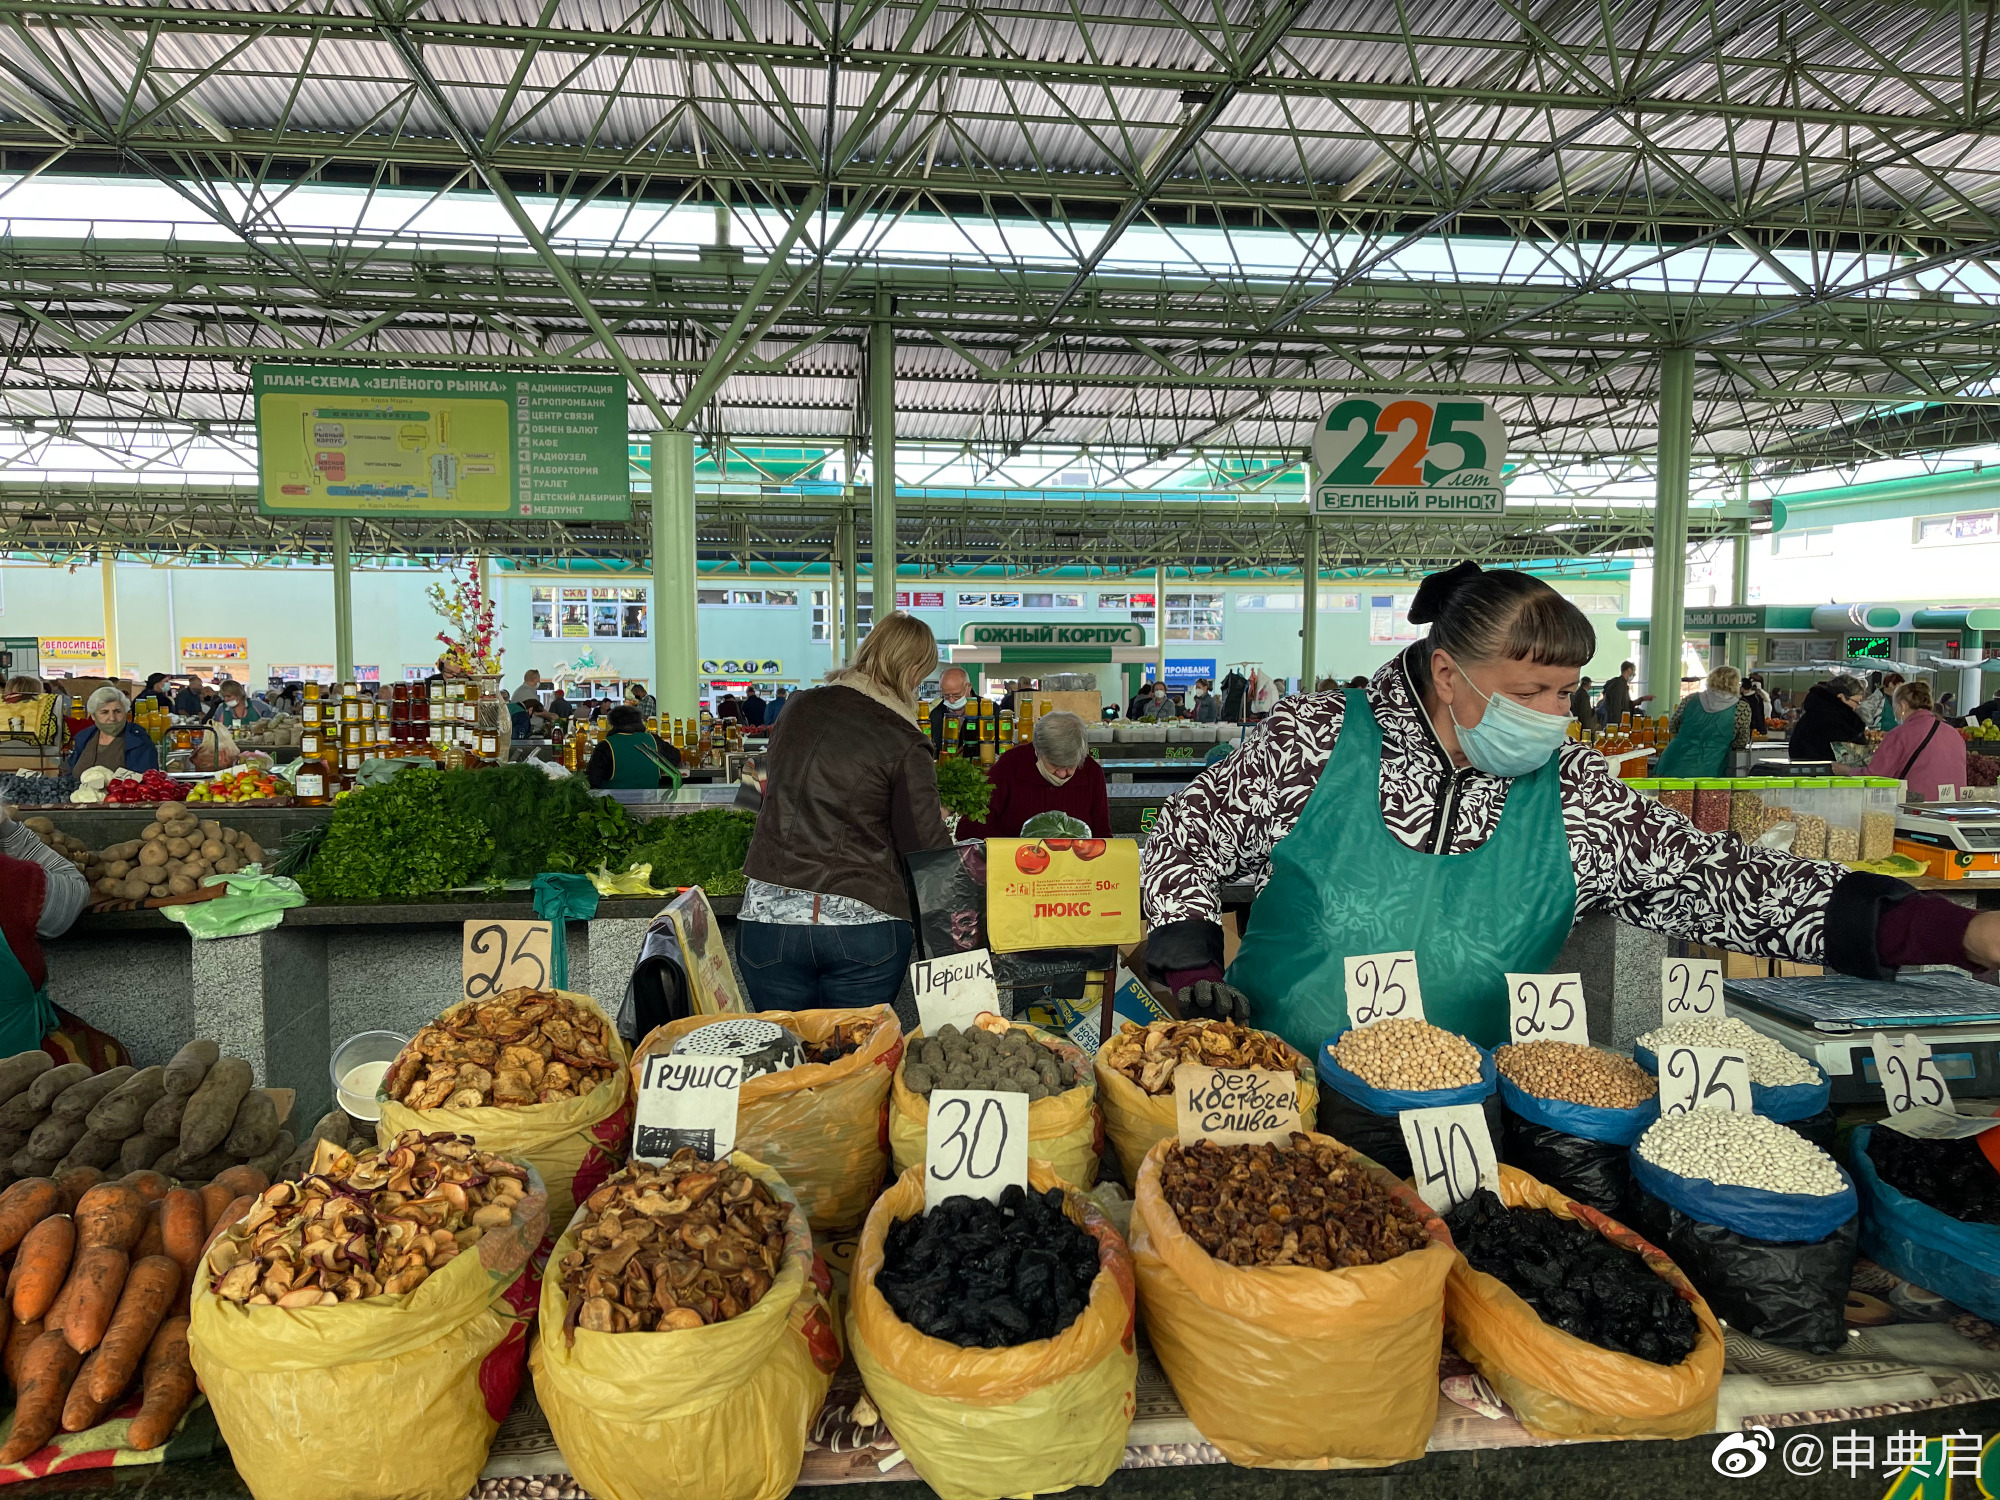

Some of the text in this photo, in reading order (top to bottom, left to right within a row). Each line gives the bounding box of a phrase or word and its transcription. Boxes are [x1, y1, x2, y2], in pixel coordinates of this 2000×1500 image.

[263, 374, 507, 392] ПЛАН-СХЕМА «ЗЕЛЁНОГО РЫНКА»
[531, 384, 613, 395] АДМИНИСТРАЦИЯ
[531, 398, 606, 407] АГРОПРОМБАНК
[531, 412, 594, 420] ЦЕНТР СВЯЗИ
[532, 425, 598, 434] ОБМЕН ВАЛЮТ
[532, 439, 558, 447] КАФЕ
[1322, 399, 1487, 486] 225
[532, 453, 587, 461] РАДИОУЗЕЛ
[533, 466, 598, 475] ЛАБОРАТОРИЯ
[533, 480, 567, 488] ТУАЛЕТ
[533, 493, 627, 502] ДЕТСКИЙ ЛАБИРИНТ
[1324, 491, 1497, 510] ЗЕЛЕНЫЙ РЫНОК
[534, 506, 583, 515] МЕДПУНКТ
[1684, 611, 1756, 624] ЛЬНЫЙ КОРПУС
[974, 626, 1131, 643] ЮЖНЫЙ КОРПУС
[45, 641, 104, 649] ВЕЛОСИПЕДЫ
[1146, 666, 1210, 674] АГПРОМБАНК
[1165, 747, 1193, 759] 542
[1034, 902, 1091, 918] ЛЮКС
[466, 924, 548, 997] 25
[915, 959, 995, 996] Персик
[1357, 959, 1413, 1023] 25
[1667, 965, 1719, 1014] 25
[1516, 981, 1577, 1036] 25
[643, 1053, 738, 1091] Груша
[1669, 1049, 1743, 1114] 25
[1888, 1056, 1945, 1110] 25
[930, 1099, 1008, 1180] 30
[1413, 1120, 1480, 1204] 40
